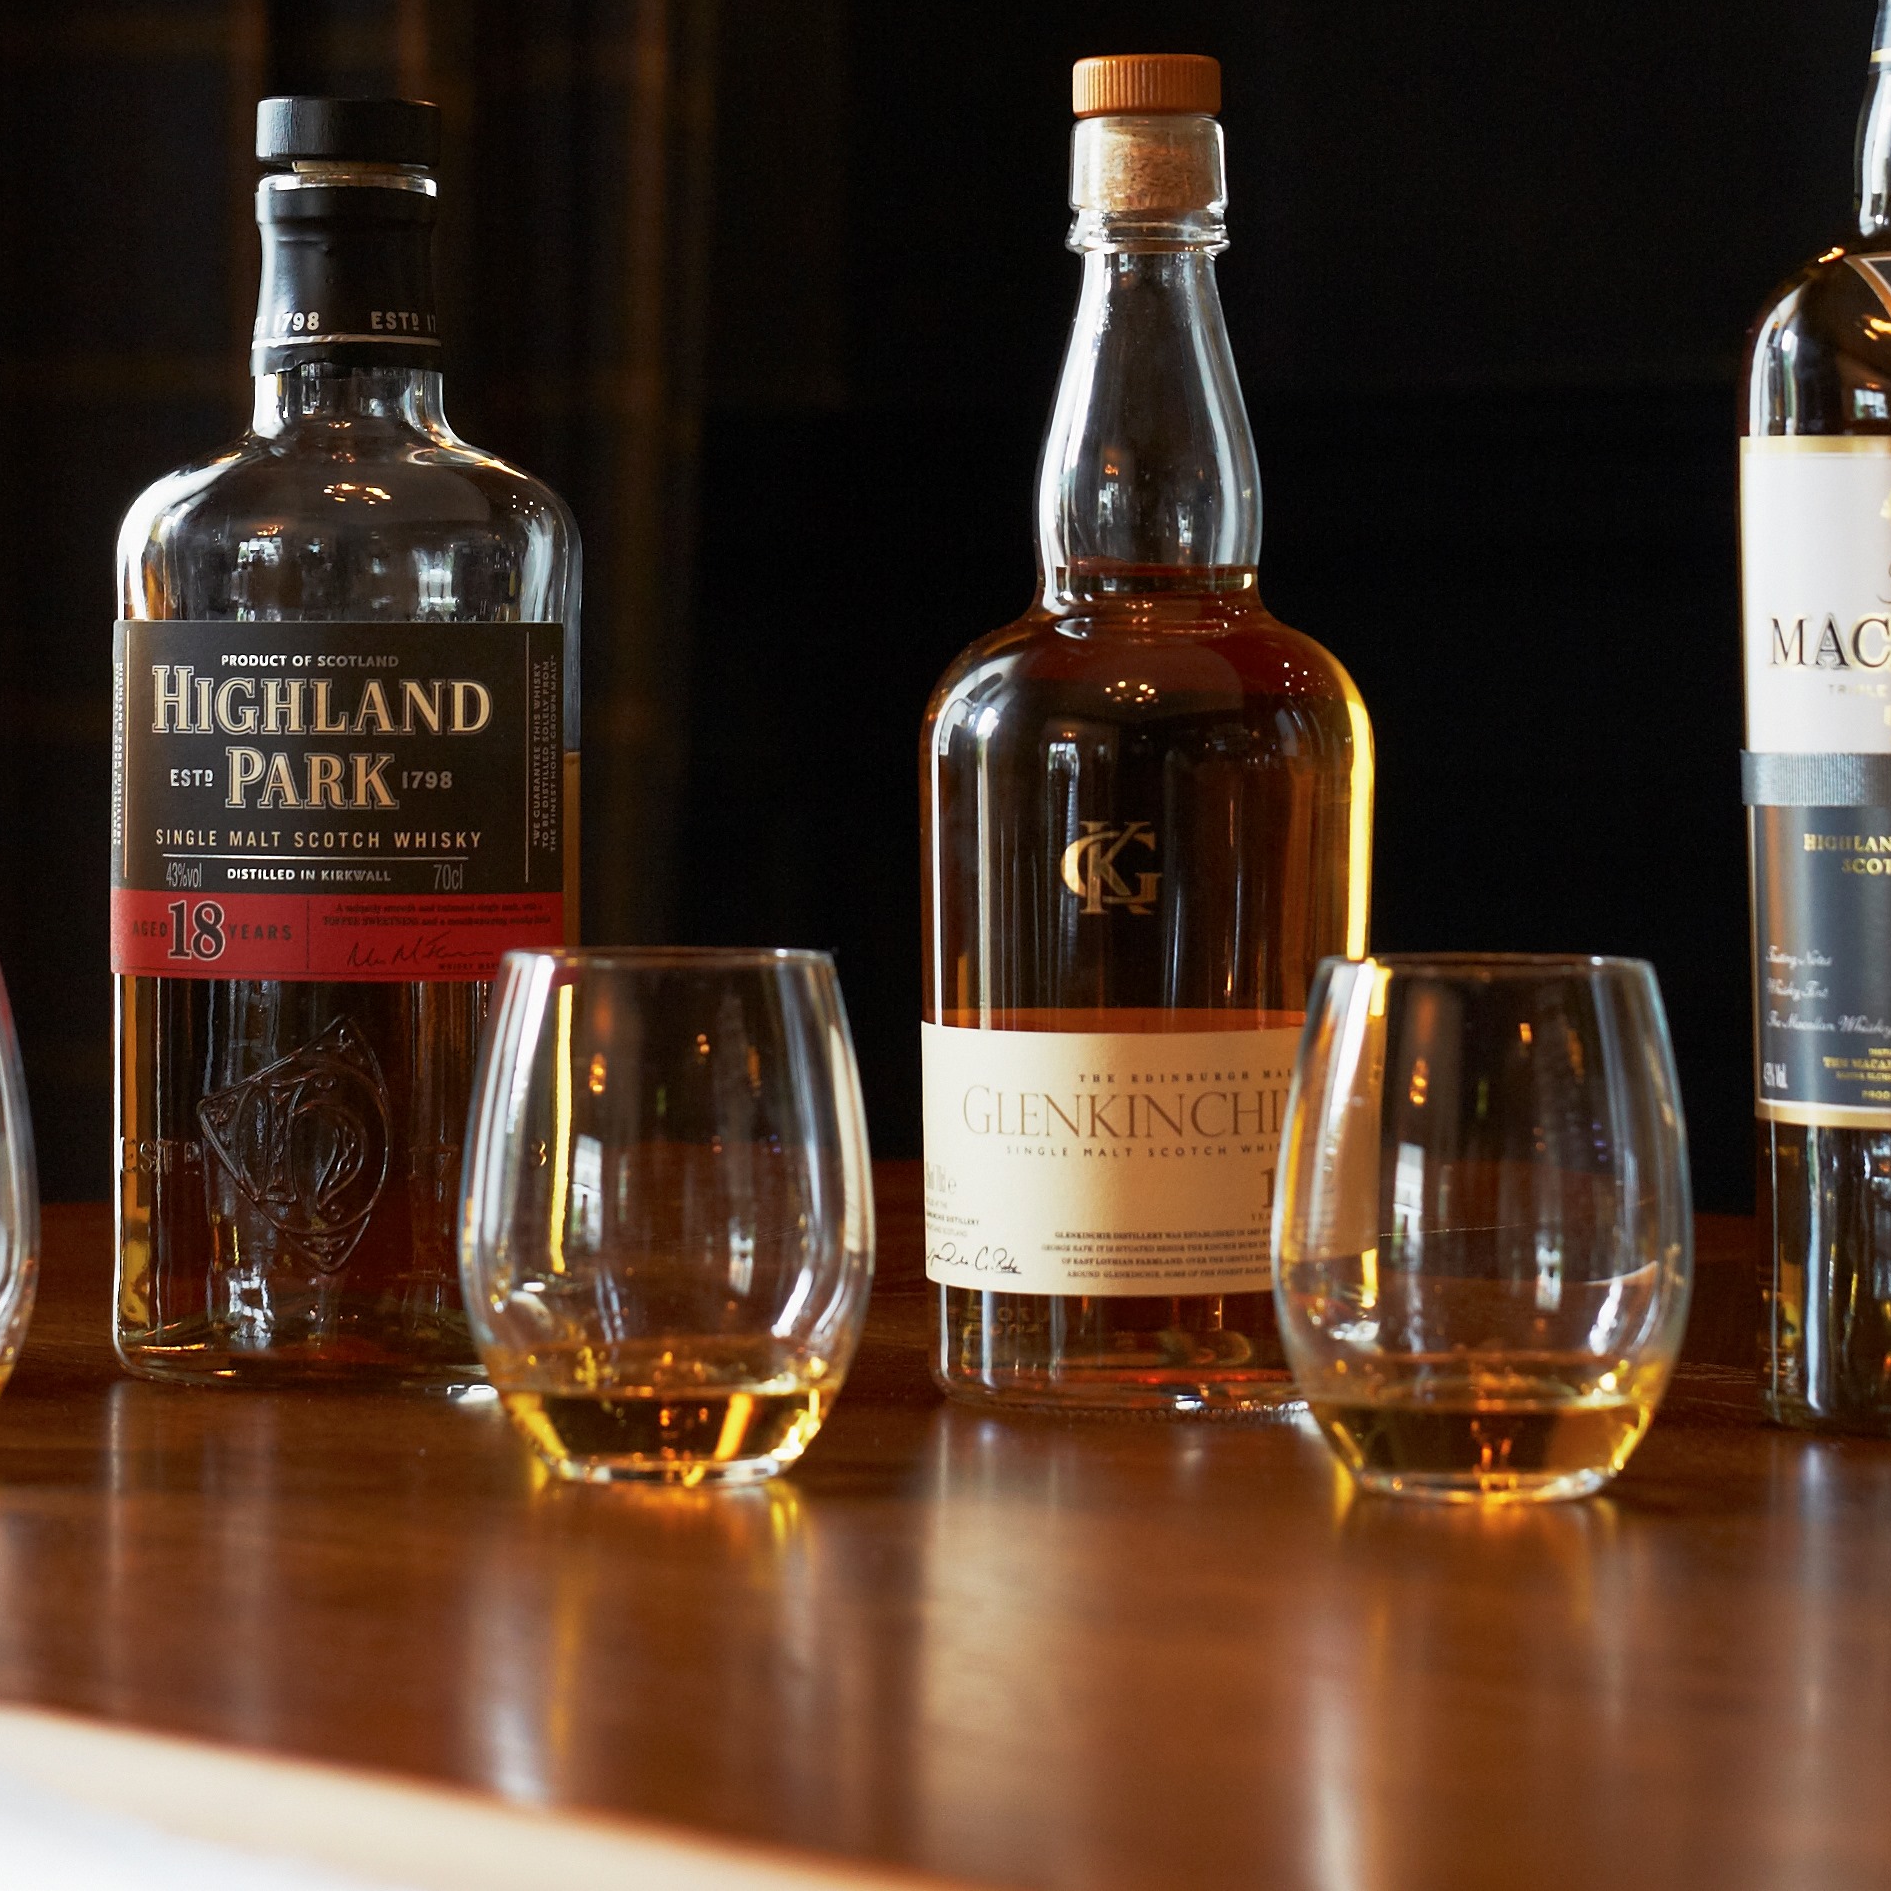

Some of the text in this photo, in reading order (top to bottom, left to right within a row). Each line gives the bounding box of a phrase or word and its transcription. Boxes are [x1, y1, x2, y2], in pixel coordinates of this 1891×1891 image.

[221, 654, 400, 668] PRODUCT OF SCOTLAND
[151, 665, 493, 736] HIGHLAND
[225, 746, 400, 810] PARK
[402, 770, 453, 790] 1798
[156, 828, 482, 849] SINGLE MALT SCOTCH WHISKY
[166, 862, 464, 891] 43%vol DISTILLED IN KIRKWALL 70cl
[132, 899, 293, 961] AGED 18 YEARS
[1079, 1069, 1294, 1084] THE EDINBURGH MAL
[963, 1084, 1290, 1140] GLENKINCHI
[1006, 1145, 1068, 1157] SINGLE
[1084, 1147, 1133, 1158] MALT
[1148, 1145, 1227, 1158] SCOTCH
[1261, 1167, 1275, 1209] 1
